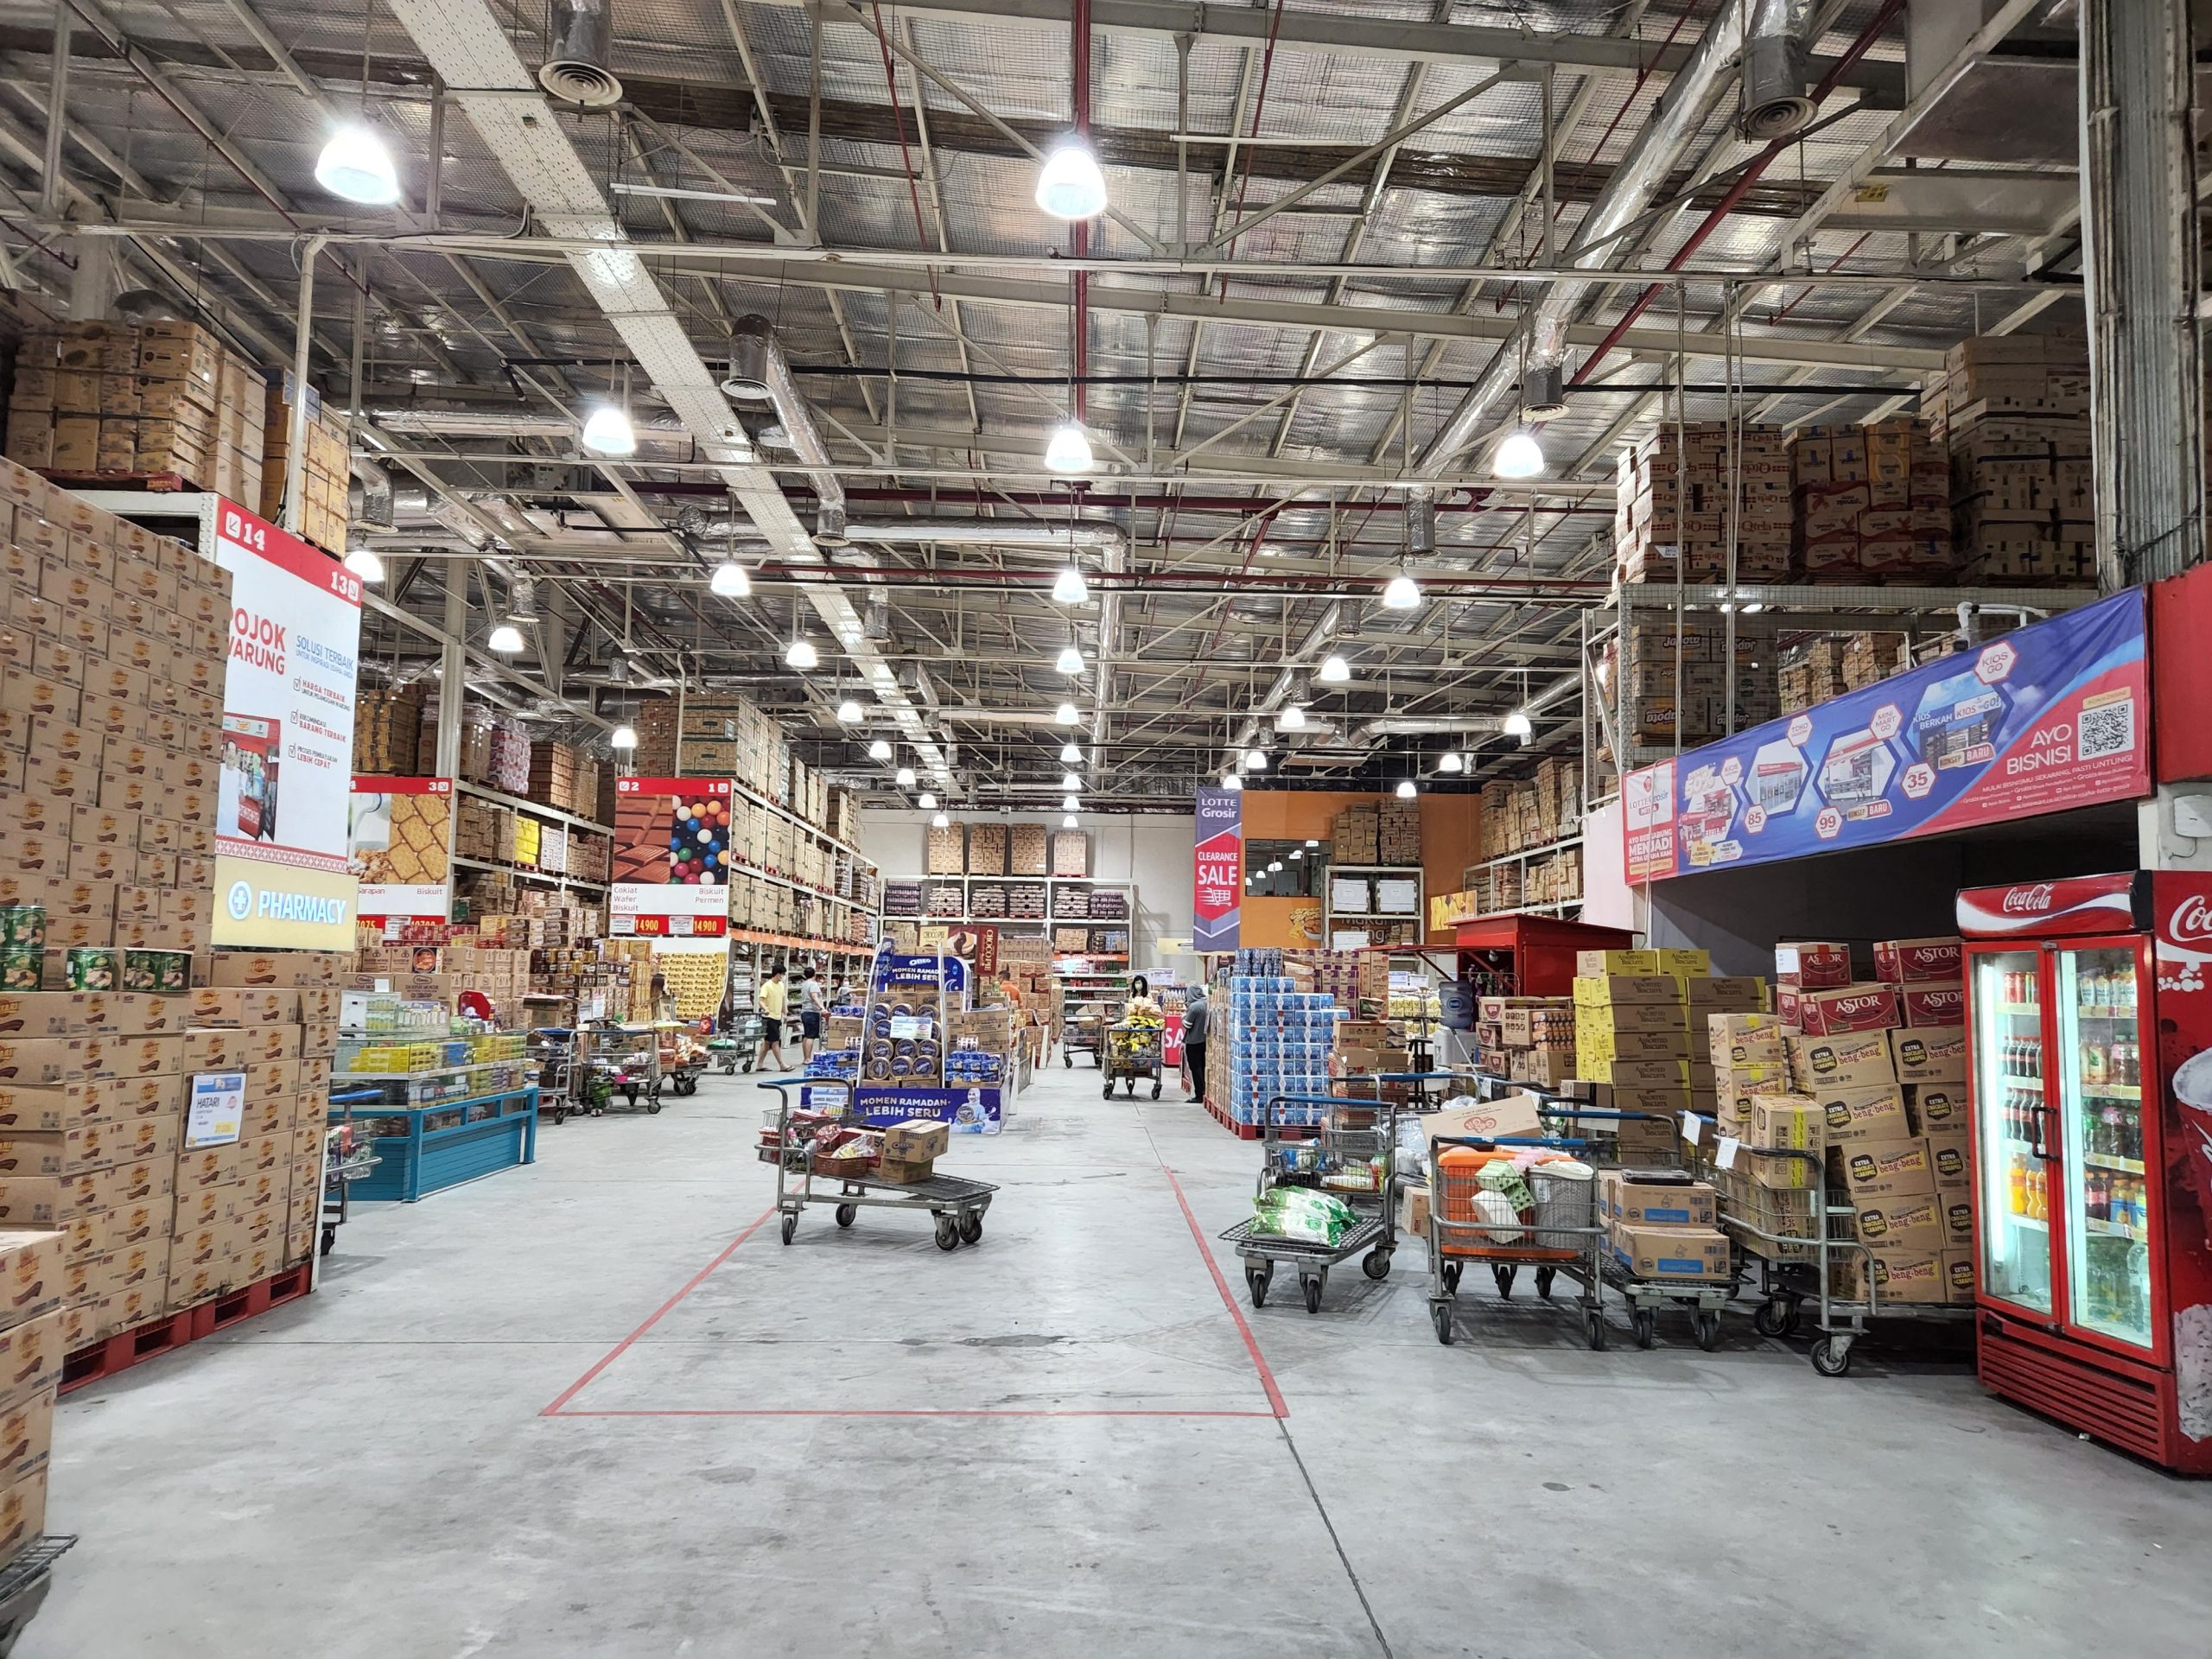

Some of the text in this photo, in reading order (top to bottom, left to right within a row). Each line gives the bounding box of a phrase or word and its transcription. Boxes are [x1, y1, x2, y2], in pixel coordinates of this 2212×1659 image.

[244, 523, 265, 551] 14
[331, 571, 347, 594] 13
[232, 607, 286, 652] OJOK
[296, 635, 353, 671] SOLUSI TERBAIK
[1982, 652, 2008, 666] KIOS
[1987, 663, 2003, 674] GO
[302, 679, 345, 702] HARGA TERBAIK
[1792, 723, 1808, 733] TOKO
[1876, 716, 1896, 728] MART
[1920, 714, 1953, 730] BERKAH
[299, 721, 346, 743] BARANG TERBAIK
[2031, 724, 2072, 749] AYO
[297, 753, 331, 769] LEBIH CEPAT
[1967, 747, 1989, 761] BARU
[2006, 745, 2071, 775] BISNIS!
[429, 782, 437, 791] 3
[631, 782, 715, 792] 2 1
[1907, 772, 1928, 788] 35
[1202, 808, 1236, 818] Grosir
[1870, 803, 1888, 814] BARU
[1748, 813, 1762, 825] 85
[1820, 816, 1836, 830] 99
[1198, 852, 1237, 861] CLEARANCE
[1198, 865, 1236, 886] SALE
[257, 890, 346, 925] PHARMACY
[635, 919, 658, 931] 14900
[694, 920, 717, 931] 14900
[1913, 947, 1960, 962] ASTOR
[1835, 995, 1882, 1013] ASTOR
[1165, 1027, 1185, 1048] SA
[1735, 1031, 1776, 1044] beng-beng
[1838, 1047, 1881, 1065] beng-beng
[1928, 1045, 1966, 1059] beng-ben
[1740, 1083, 1780, 1096] beng-beng
[196, 1097, 219, 1108] HATARI
[860, 1097, 948, 1107] MOMEN RAMADAN
[866, 1106, 941, 1117] LEBIH SERU
[1853, 1102, 1895, 1119] beng-beng
[1878, 1155, 1922, 1173] beng-beng
[1889, 1212, 1931, 1229] beng-beng
[1891, 1267, 1935, 1280] beng-beng
